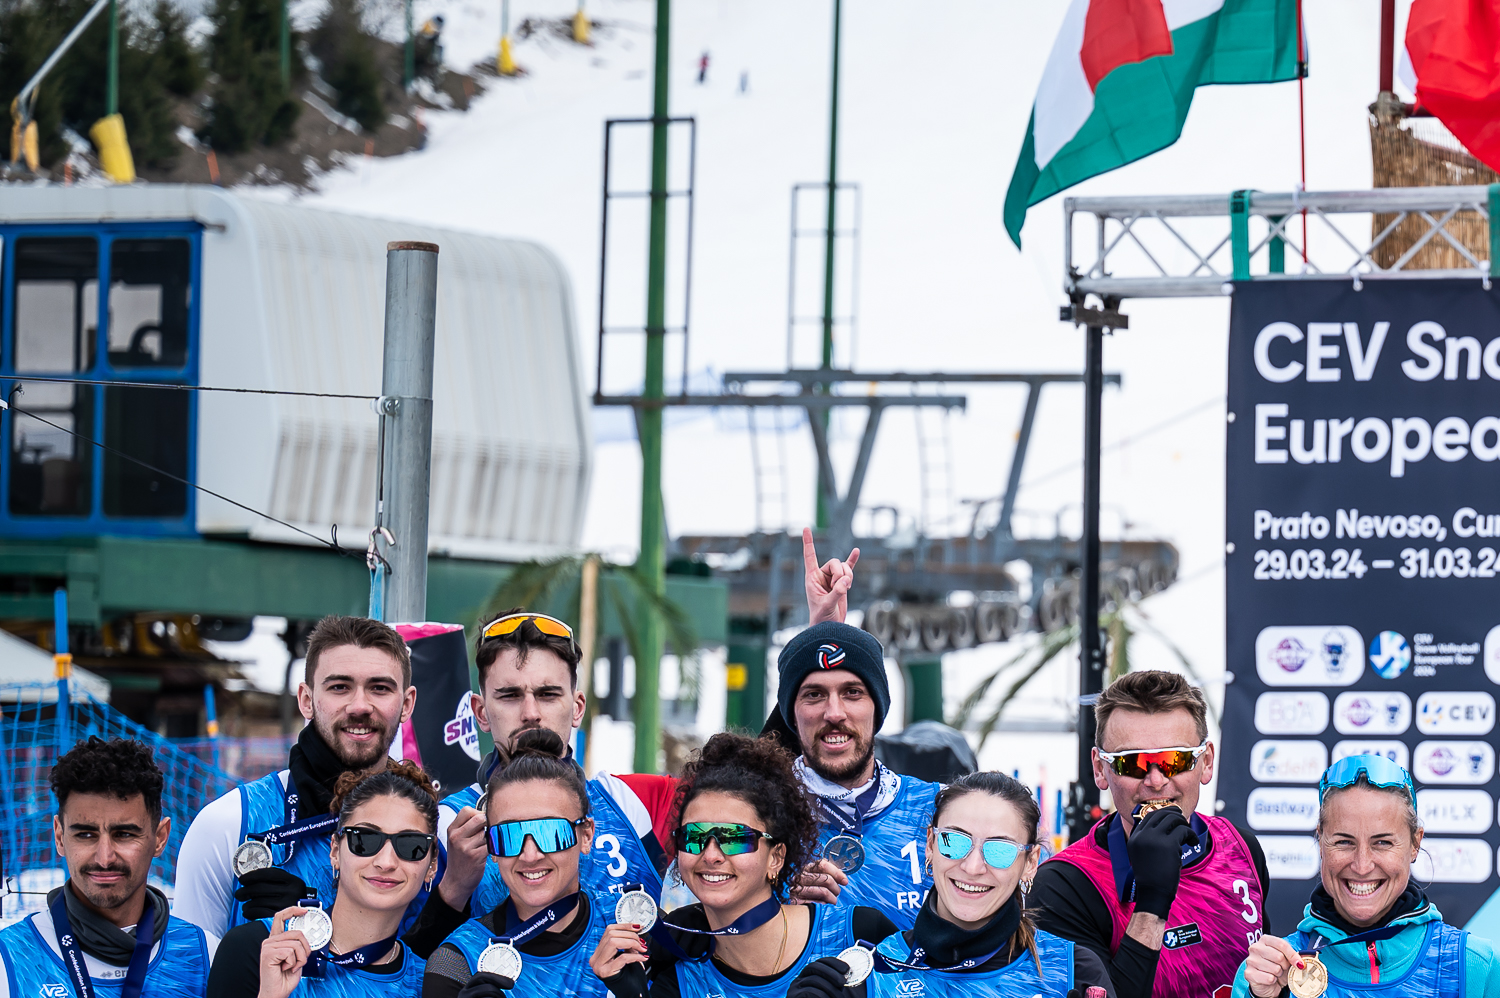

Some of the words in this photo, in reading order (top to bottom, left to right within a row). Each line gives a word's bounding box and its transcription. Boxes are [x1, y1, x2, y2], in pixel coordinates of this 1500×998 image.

[1253, 320, 1390, 383] CEV
[1253, 509, 1330, 540] Prato
[1335, 509, 1447, 542] Nevoso,
[1253, 550, 1367, 580] 29.03.24
[1450, 705, 1489, 721] CEV
[596, 834, 628, 876] 3
[901, 840, 922, 884] 1
[1232, 879, 1258, 923] 3
[43, 984, 66, 997] V2
[899, 980, 922, 992] V2
